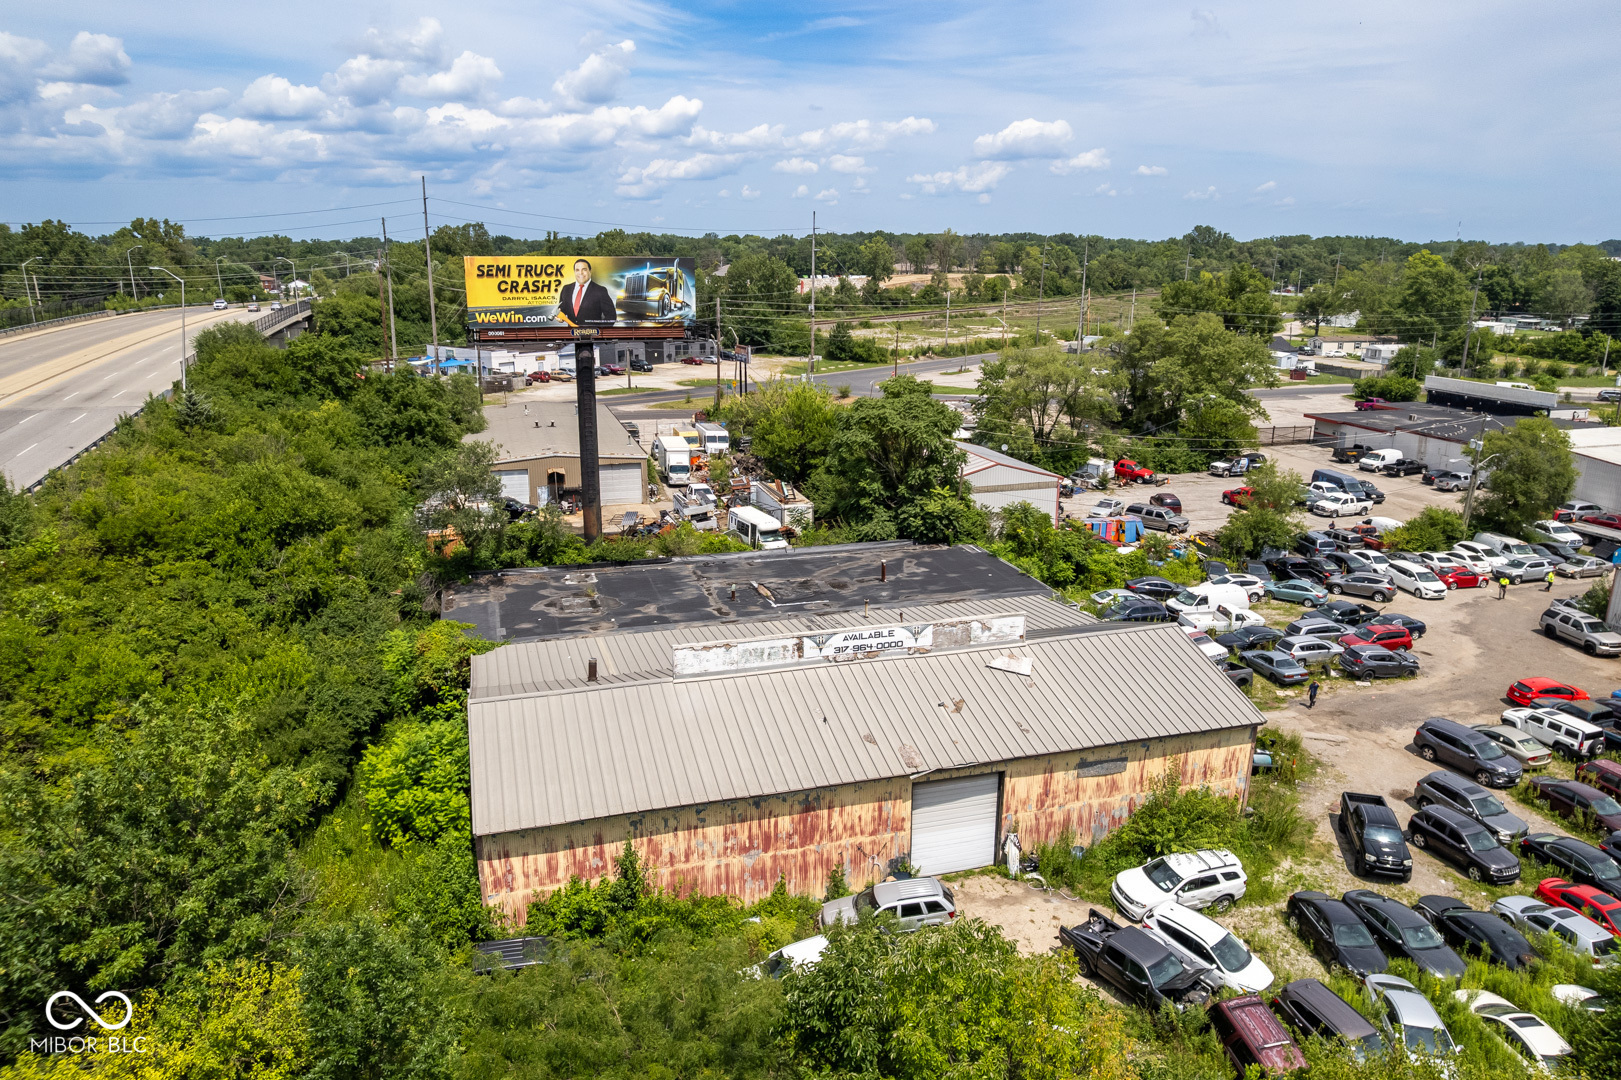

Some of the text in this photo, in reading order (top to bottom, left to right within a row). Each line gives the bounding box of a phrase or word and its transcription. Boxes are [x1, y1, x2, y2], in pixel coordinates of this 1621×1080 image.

[476, 264, 565, 278] SEMI TRUCK
[497, 279, 562, 293] CRASH?
[475, 311, 547, 324] WeWin.com
[573, 328, 598, 336] Reagan
[842, 630, 895, 642] AVAILABLE
[833, 640, 904, 654] 317-964-0000
